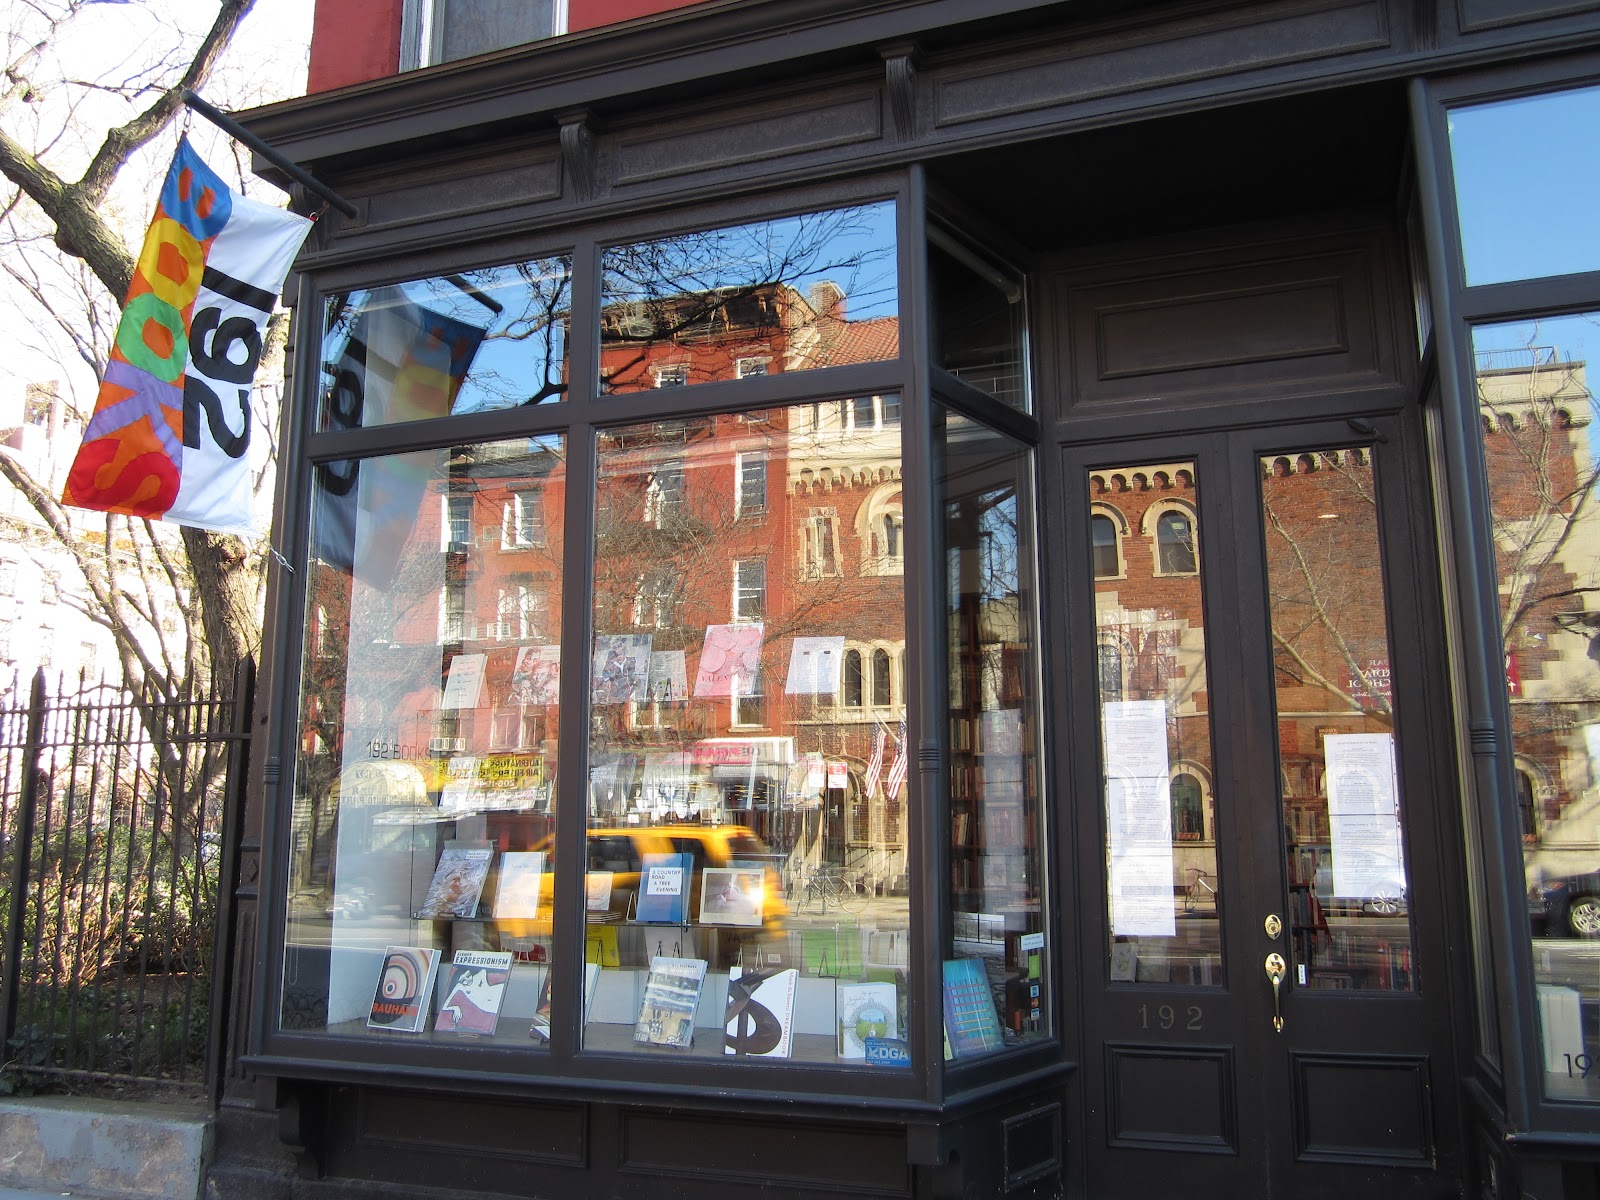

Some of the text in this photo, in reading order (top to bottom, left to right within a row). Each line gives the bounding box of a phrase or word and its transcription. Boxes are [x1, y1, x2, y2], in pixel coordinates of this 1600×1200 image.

[66, 135, 232, 517] BOOKS
[183, 265, 279, 458] 192
[366, 741, 432, 762] 192 BOOKS
[455, 956, 508, 965] EXPRESSIONISM
[781, 1012, 790, 1055] DREAMBOOK
[1138, 1004, 1203, 1030] 192
